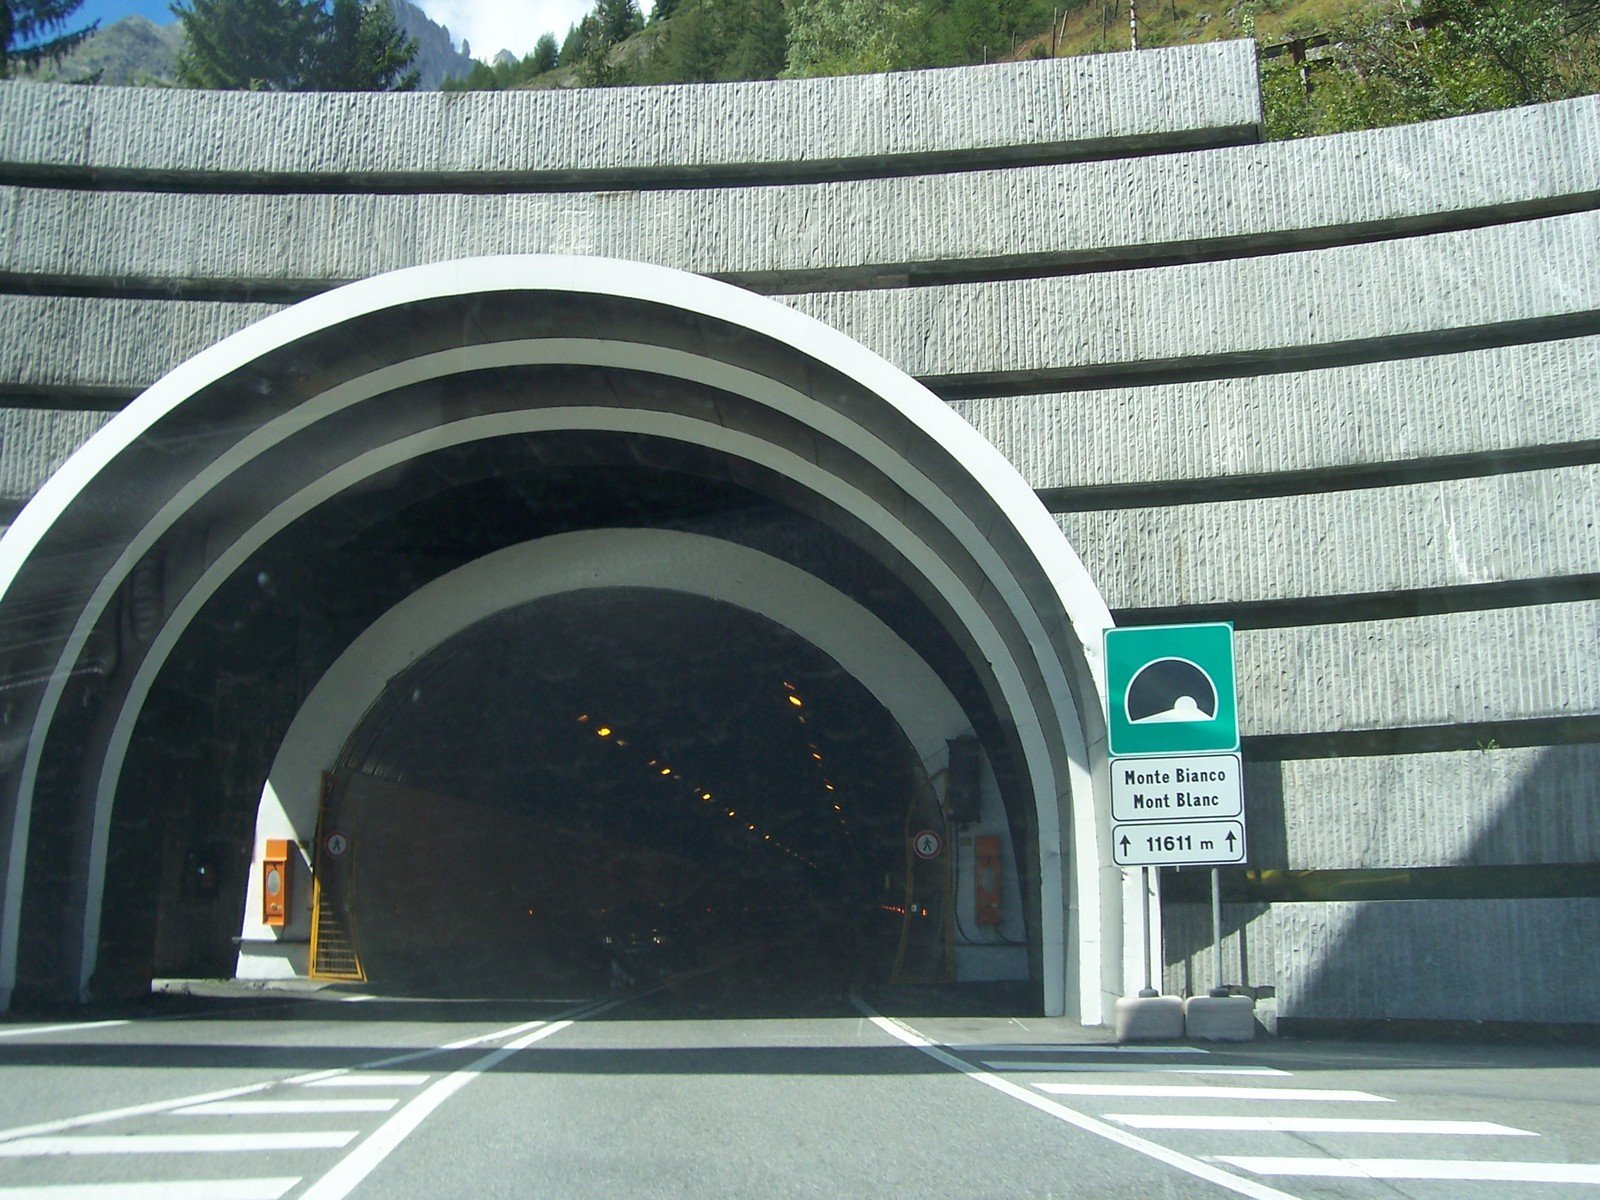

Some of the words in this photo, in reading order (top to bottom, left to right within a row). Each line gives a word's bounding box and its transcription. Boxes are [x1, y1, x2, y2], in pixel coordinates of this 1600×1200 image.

[1124, 770, 1170, 785] Monte
[1176, 768, 1226, 783] Bianco
[1133, 793, 1171, 809] Mont
[1176, 792, 1219, 807] Blanc
[1146, 835, 1192, 852] 11611
[1200, 839, 1214, 850] m
